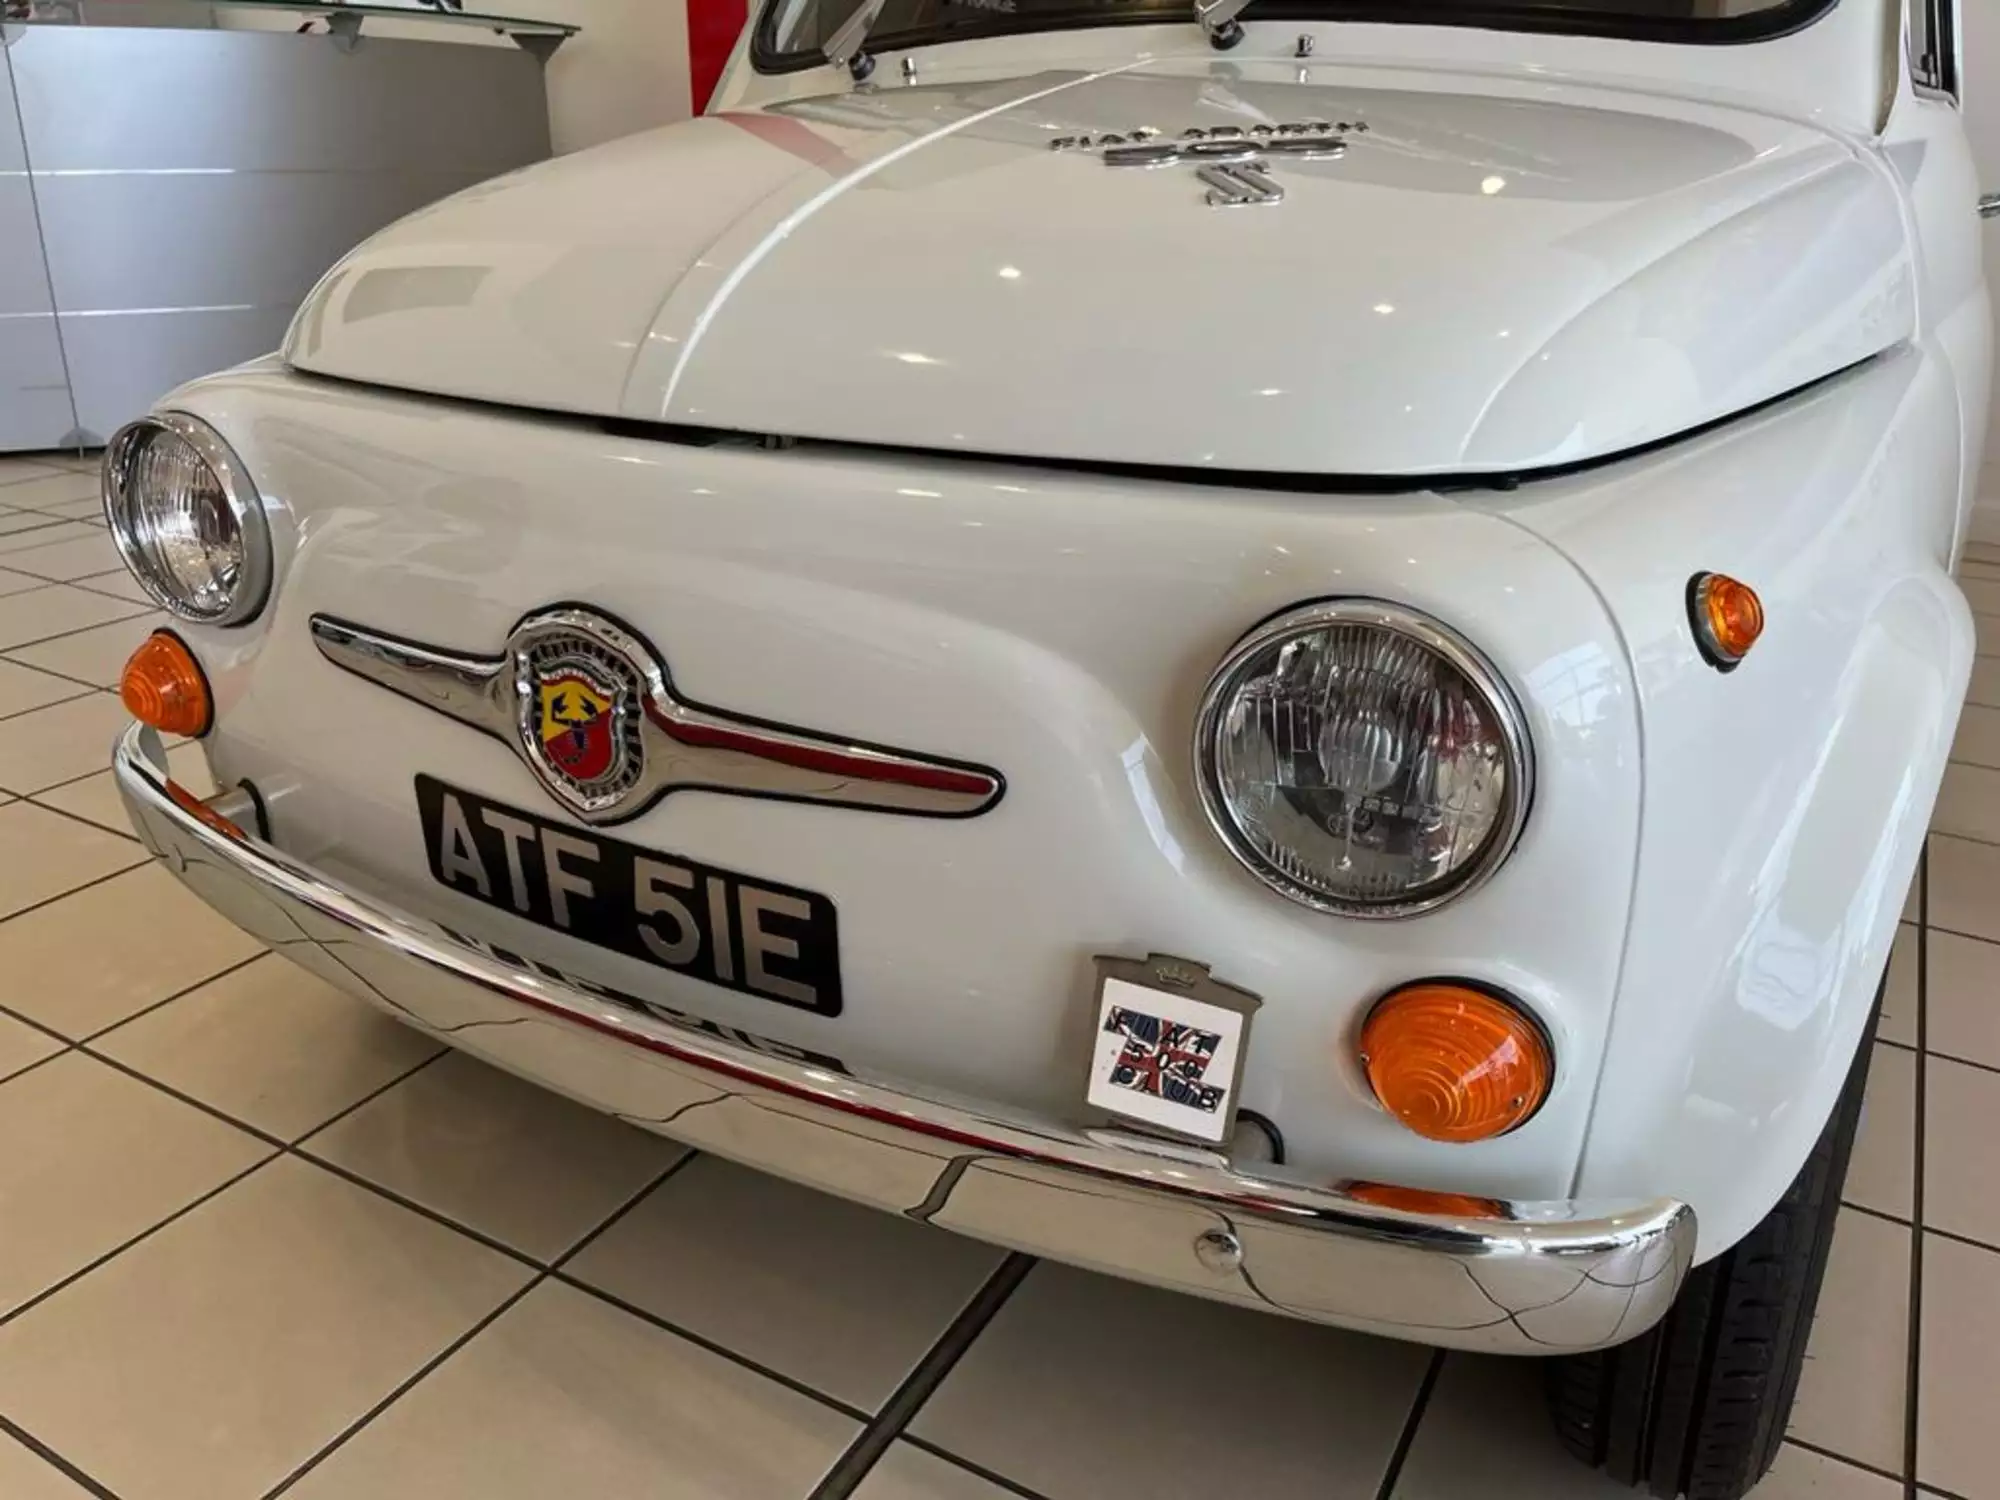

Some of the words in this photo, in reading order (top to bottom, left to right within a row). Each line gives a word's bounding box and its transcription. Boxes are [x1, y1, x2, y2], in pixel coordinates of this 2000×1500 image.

[1049, 130, 1155, 153] FIAT
[1186, 121, 1370, 142] ABARTH
[440, 791, 601, 929] ATF
[634, 855, 818, 1006] 51E
